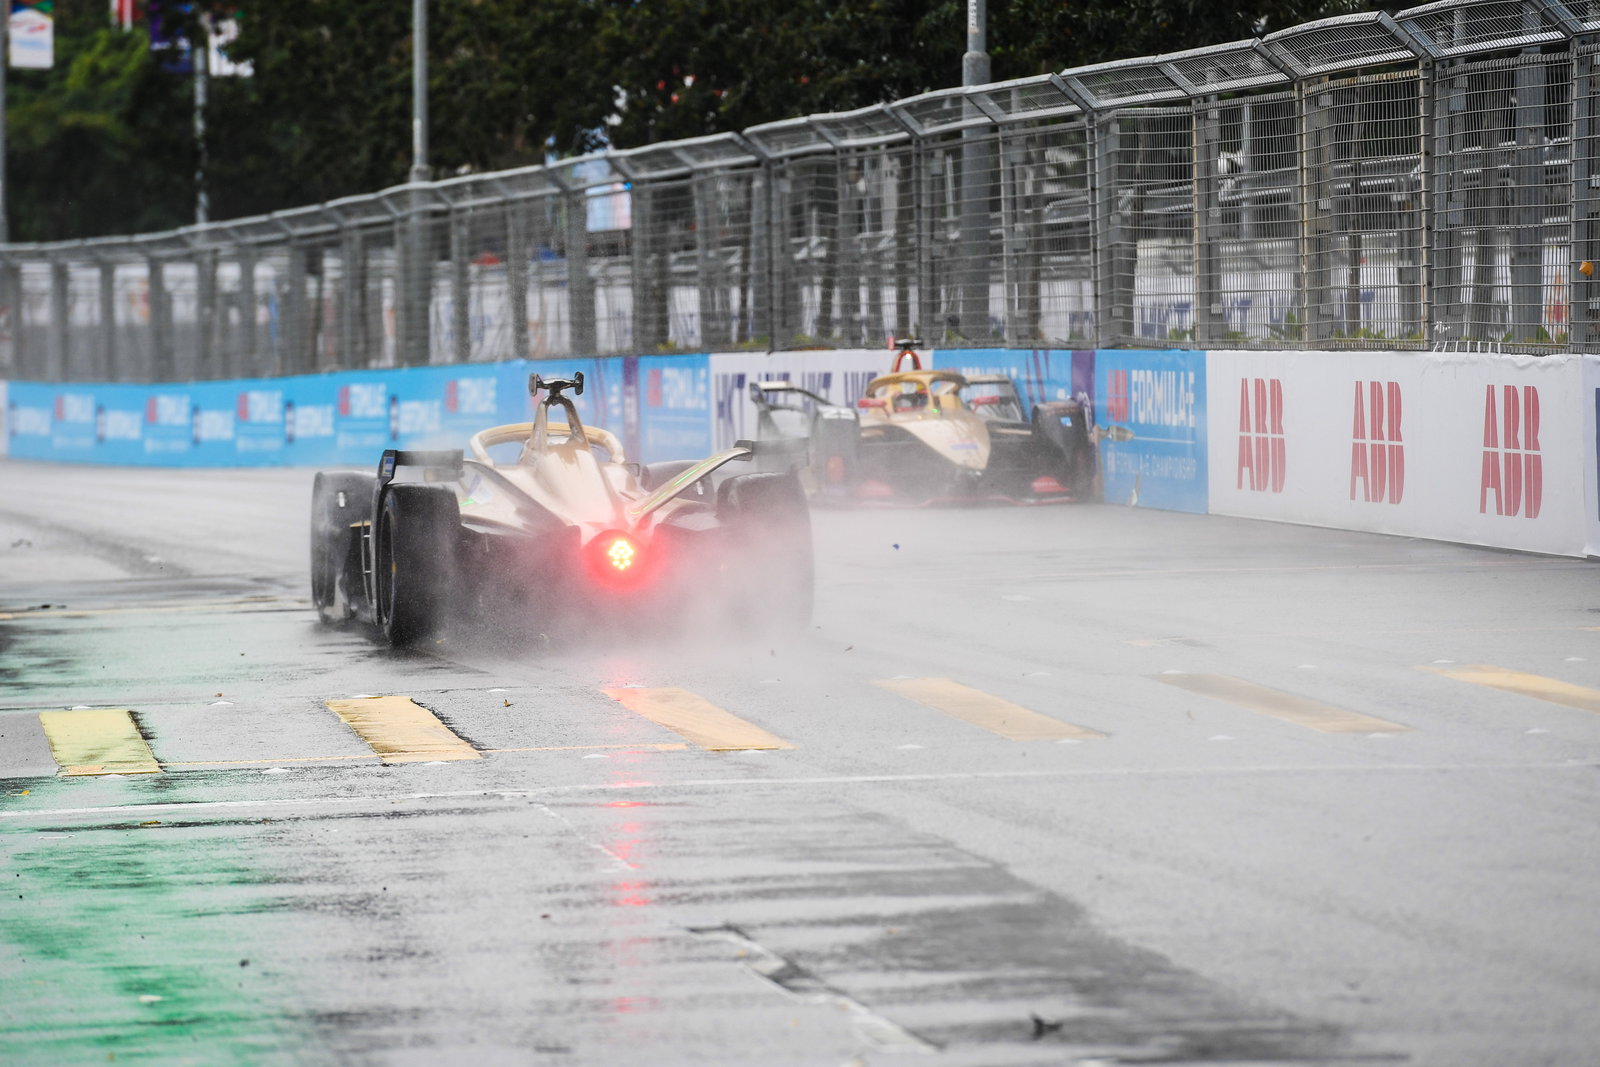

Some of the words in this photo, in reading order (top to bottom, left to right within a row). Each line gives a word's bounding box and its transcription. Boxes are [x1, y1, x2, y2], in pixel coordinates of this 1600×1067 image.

[1107, 368, 1129, 422] ABB
[1237, 377, 1286, 494] ABB
[1350, 380, 1405, 505] ABB
[1479, 384, 1543, 519] ABB
